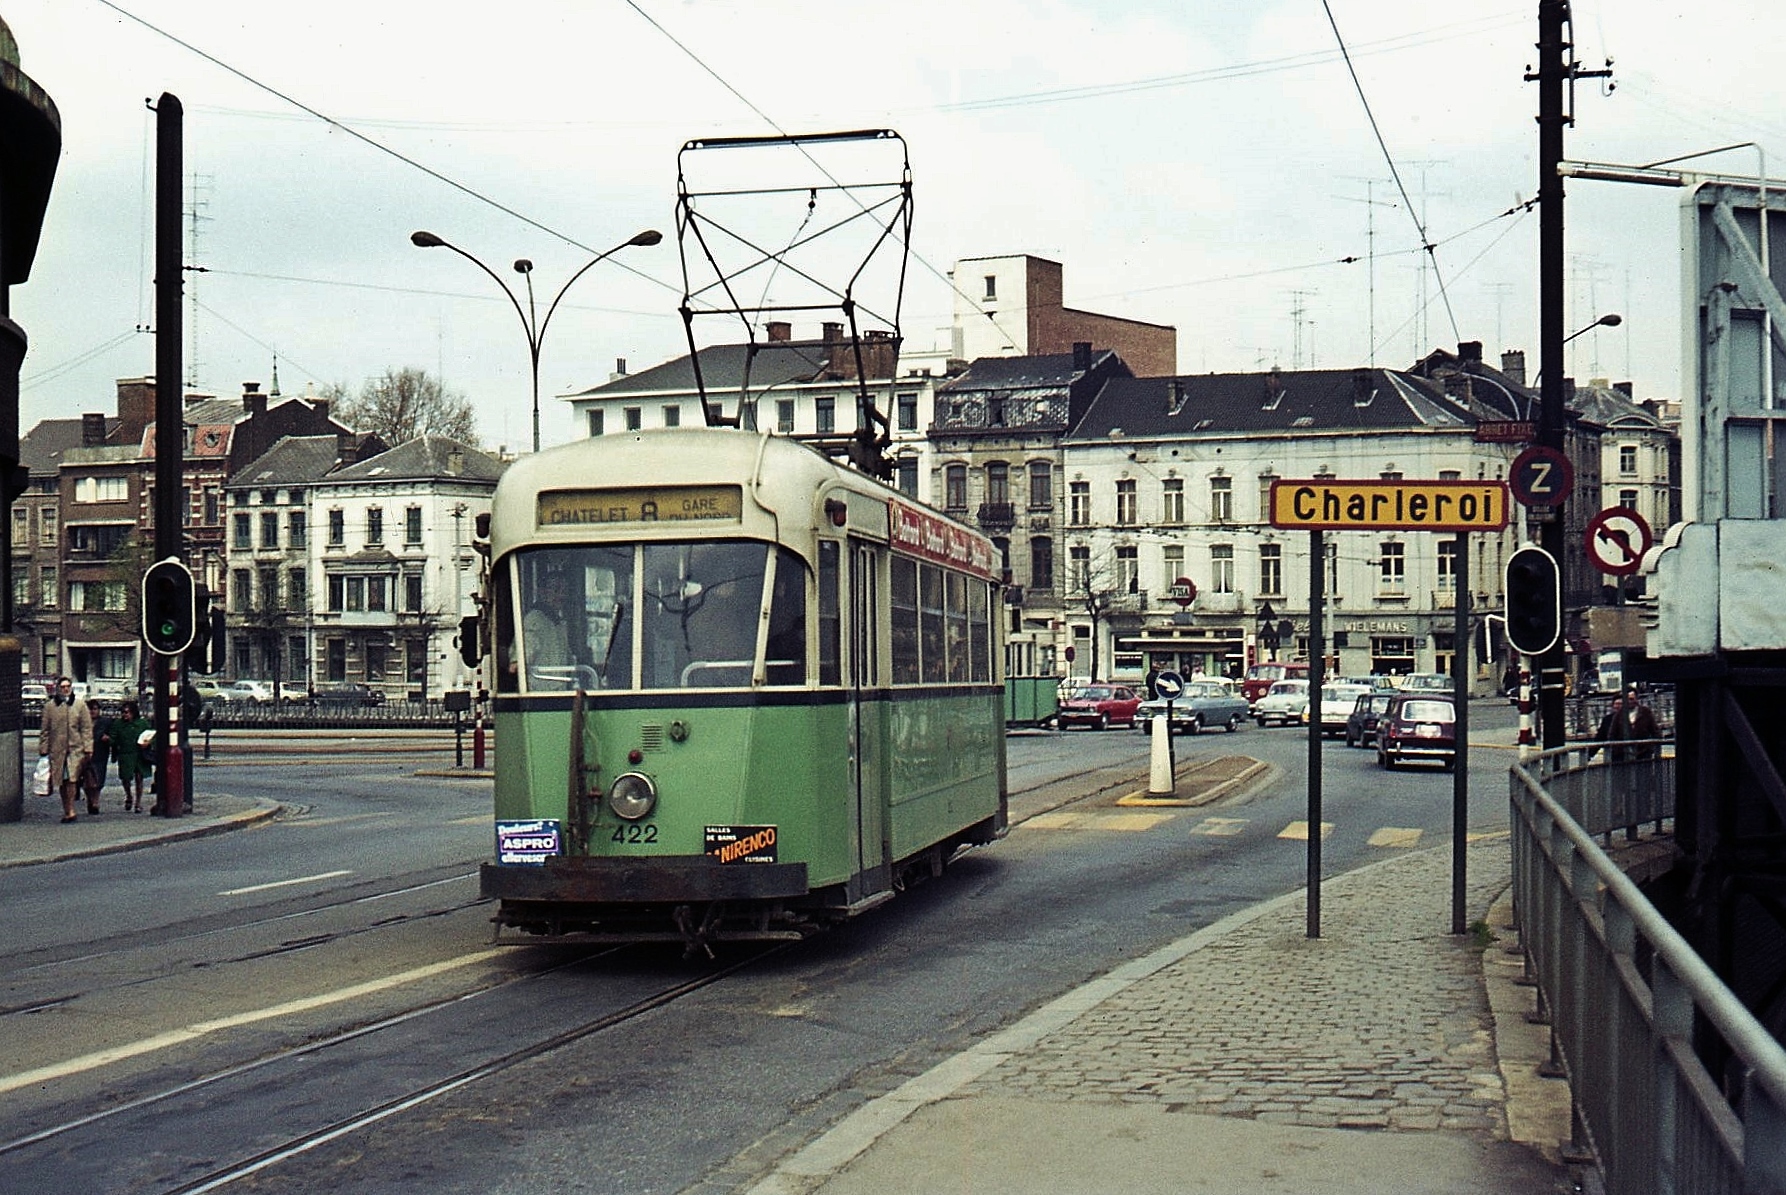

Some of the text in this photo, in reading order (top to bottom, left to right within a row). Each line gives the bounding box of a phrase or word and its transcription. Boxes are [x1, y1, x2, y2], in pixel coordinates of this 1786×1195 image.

[1530, 463, 1552, 493] Z
[551, 506, 629, 523] CHATELET
[682, 498, 718, 512] GARE
[1293, 487, 1491, 522] Charleroi
[1344, 621, 1408, 632] WIELEMANS
[503, 838, 555, 849] ASPRO
[611, 824, 658, 844] 422
[706, 828, 775, 864] NIRENCO
